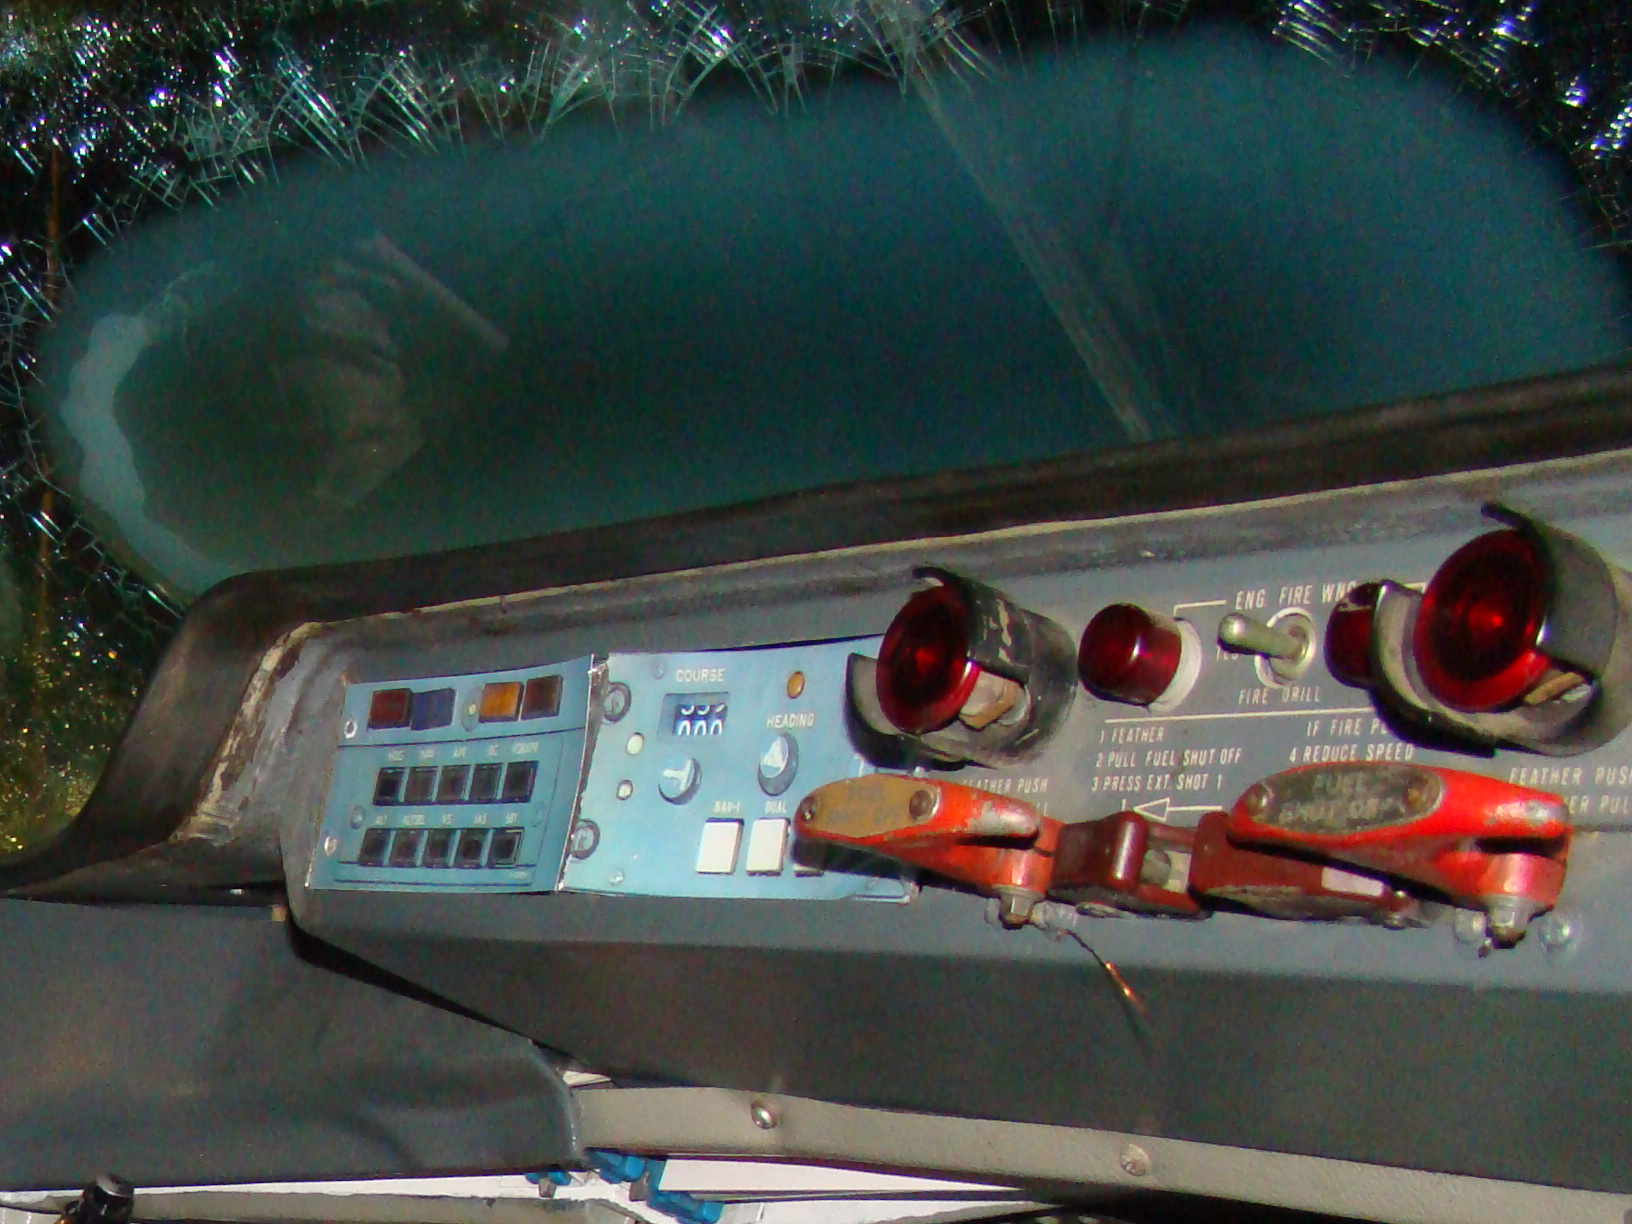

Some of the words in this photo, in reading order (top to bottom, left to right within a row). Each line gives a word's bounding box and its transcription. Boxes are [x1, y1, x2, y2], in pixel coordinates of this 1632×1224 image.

[1235, 589, 1266, 610] ENG
[1279, 585, 1313, 605] FIRE
[676, 668, 725, 682] COURSE
[1238, 688, 1268, 705] FIRE
[1282, 686, 1320, 704] DRILL
[766, 713, 814, 728] HEADING
[1306, 721, 1320, 737] IF
[1330, 719, 1361, 736] FIRE
[1111, 727, 1164, 742] FEATHER
[1096, 754, 1103, 768] 2
[1107, 752, 1136, 767] PULL
[1145, 750, 1175, 766] FUEL
[1182, 749, 1215, 766] SHUT
[1219, 747, 1242, 764] OFF
[1289, 749, 1296, 762] 4
[1302, 745, 1358, 761] REDUCE
[1365, 743, 1416, 760] SPEED
[1091, 777, 1099, 791] 3
[1103, 776, 1141, 791] PRESS
[1176, 774, 1209, 790] SHOT
[1509, 767, 1582, 785] FEATHER
[1017, 778, 1048, 793] PUSH
[765, 801, 787, 814] DUAL
